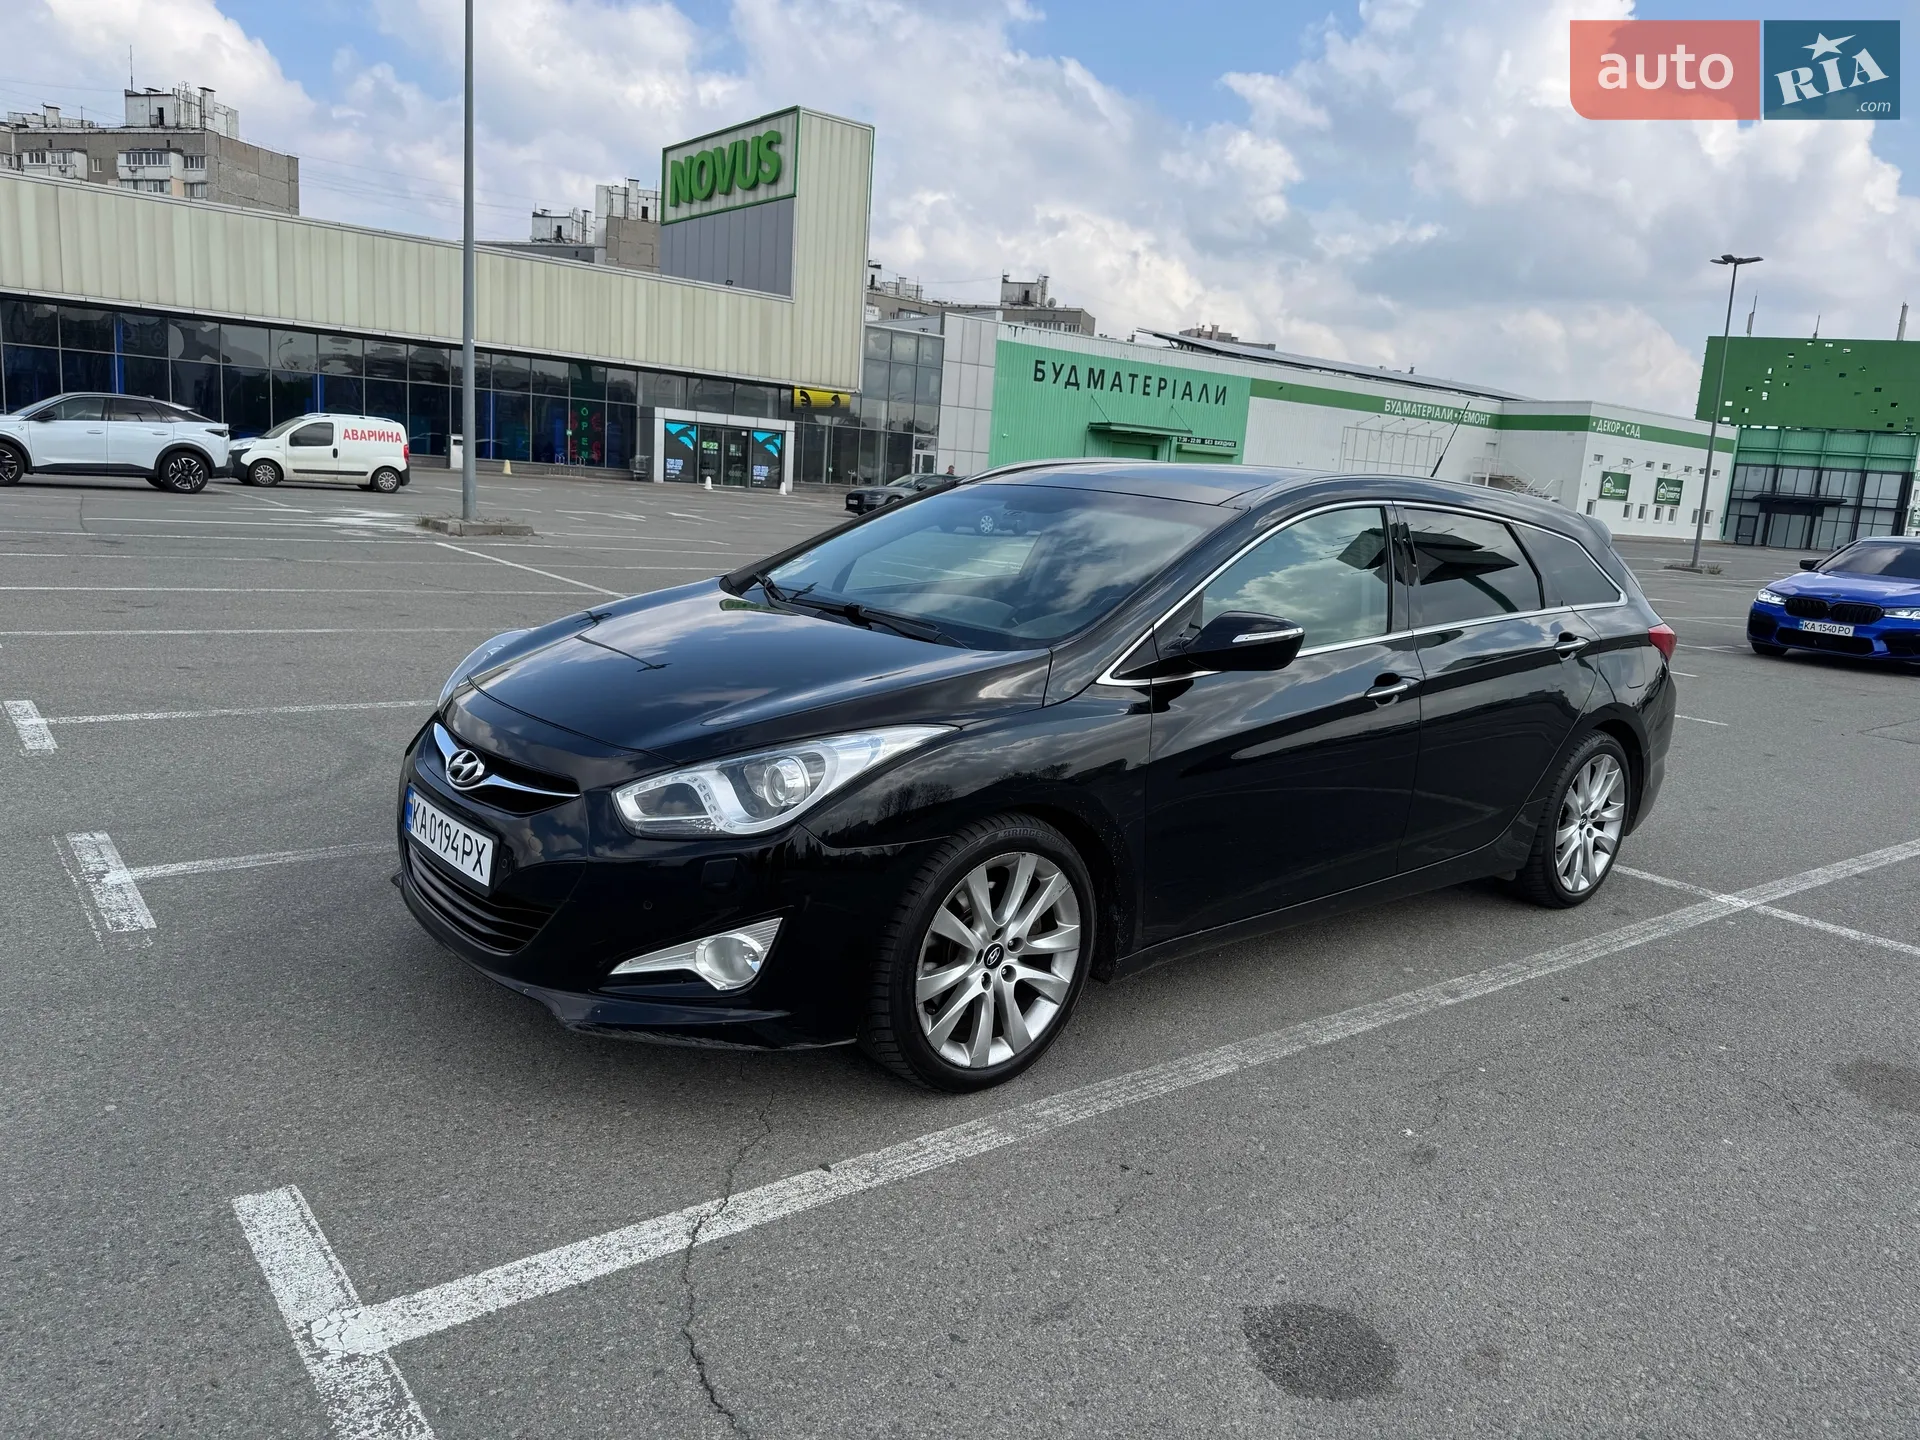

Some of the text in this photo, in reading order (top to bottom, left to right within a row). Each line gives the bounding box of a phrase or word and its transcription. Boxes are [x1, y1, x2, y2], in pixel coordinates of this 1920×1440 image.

[669, 130, 782, 208] NOVUS
[1033, 359, 1227, 406] БУДМАТЕРІАЛИ
[1384, 400, 1454, 420] БУДМАТЕРІАЛИ
[343, 428, 402, 443] АВАРІЙНА
[1596, 419, 1640, 438] ДЕКОР САД
[1818, 624, 1836, 633] 1540
